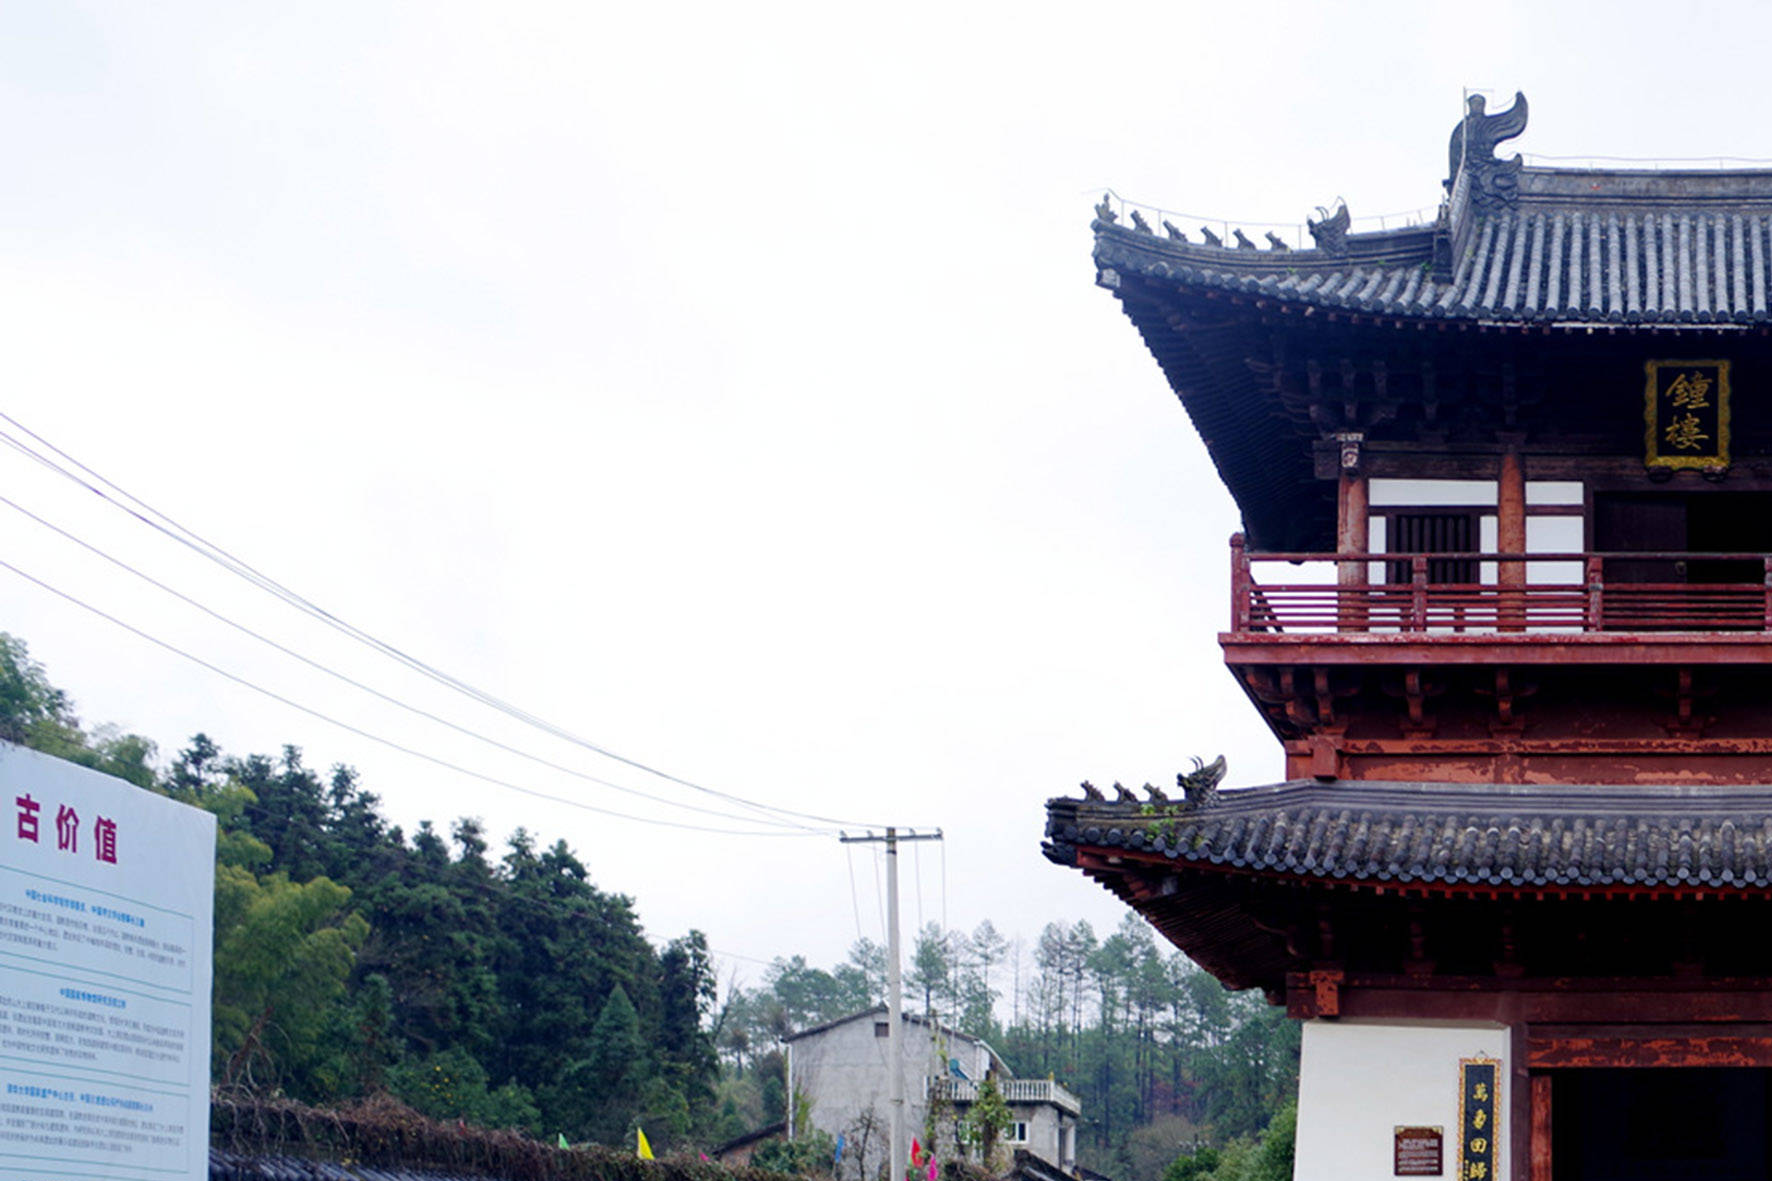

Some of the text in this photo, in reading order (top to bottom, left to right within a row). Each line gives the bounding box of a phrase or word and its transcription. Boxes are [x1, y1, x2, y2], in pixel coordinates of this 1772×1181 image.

[1664, 370, 1713, 450] 鐘樓
[15, 794, 118, 865] 古价值
